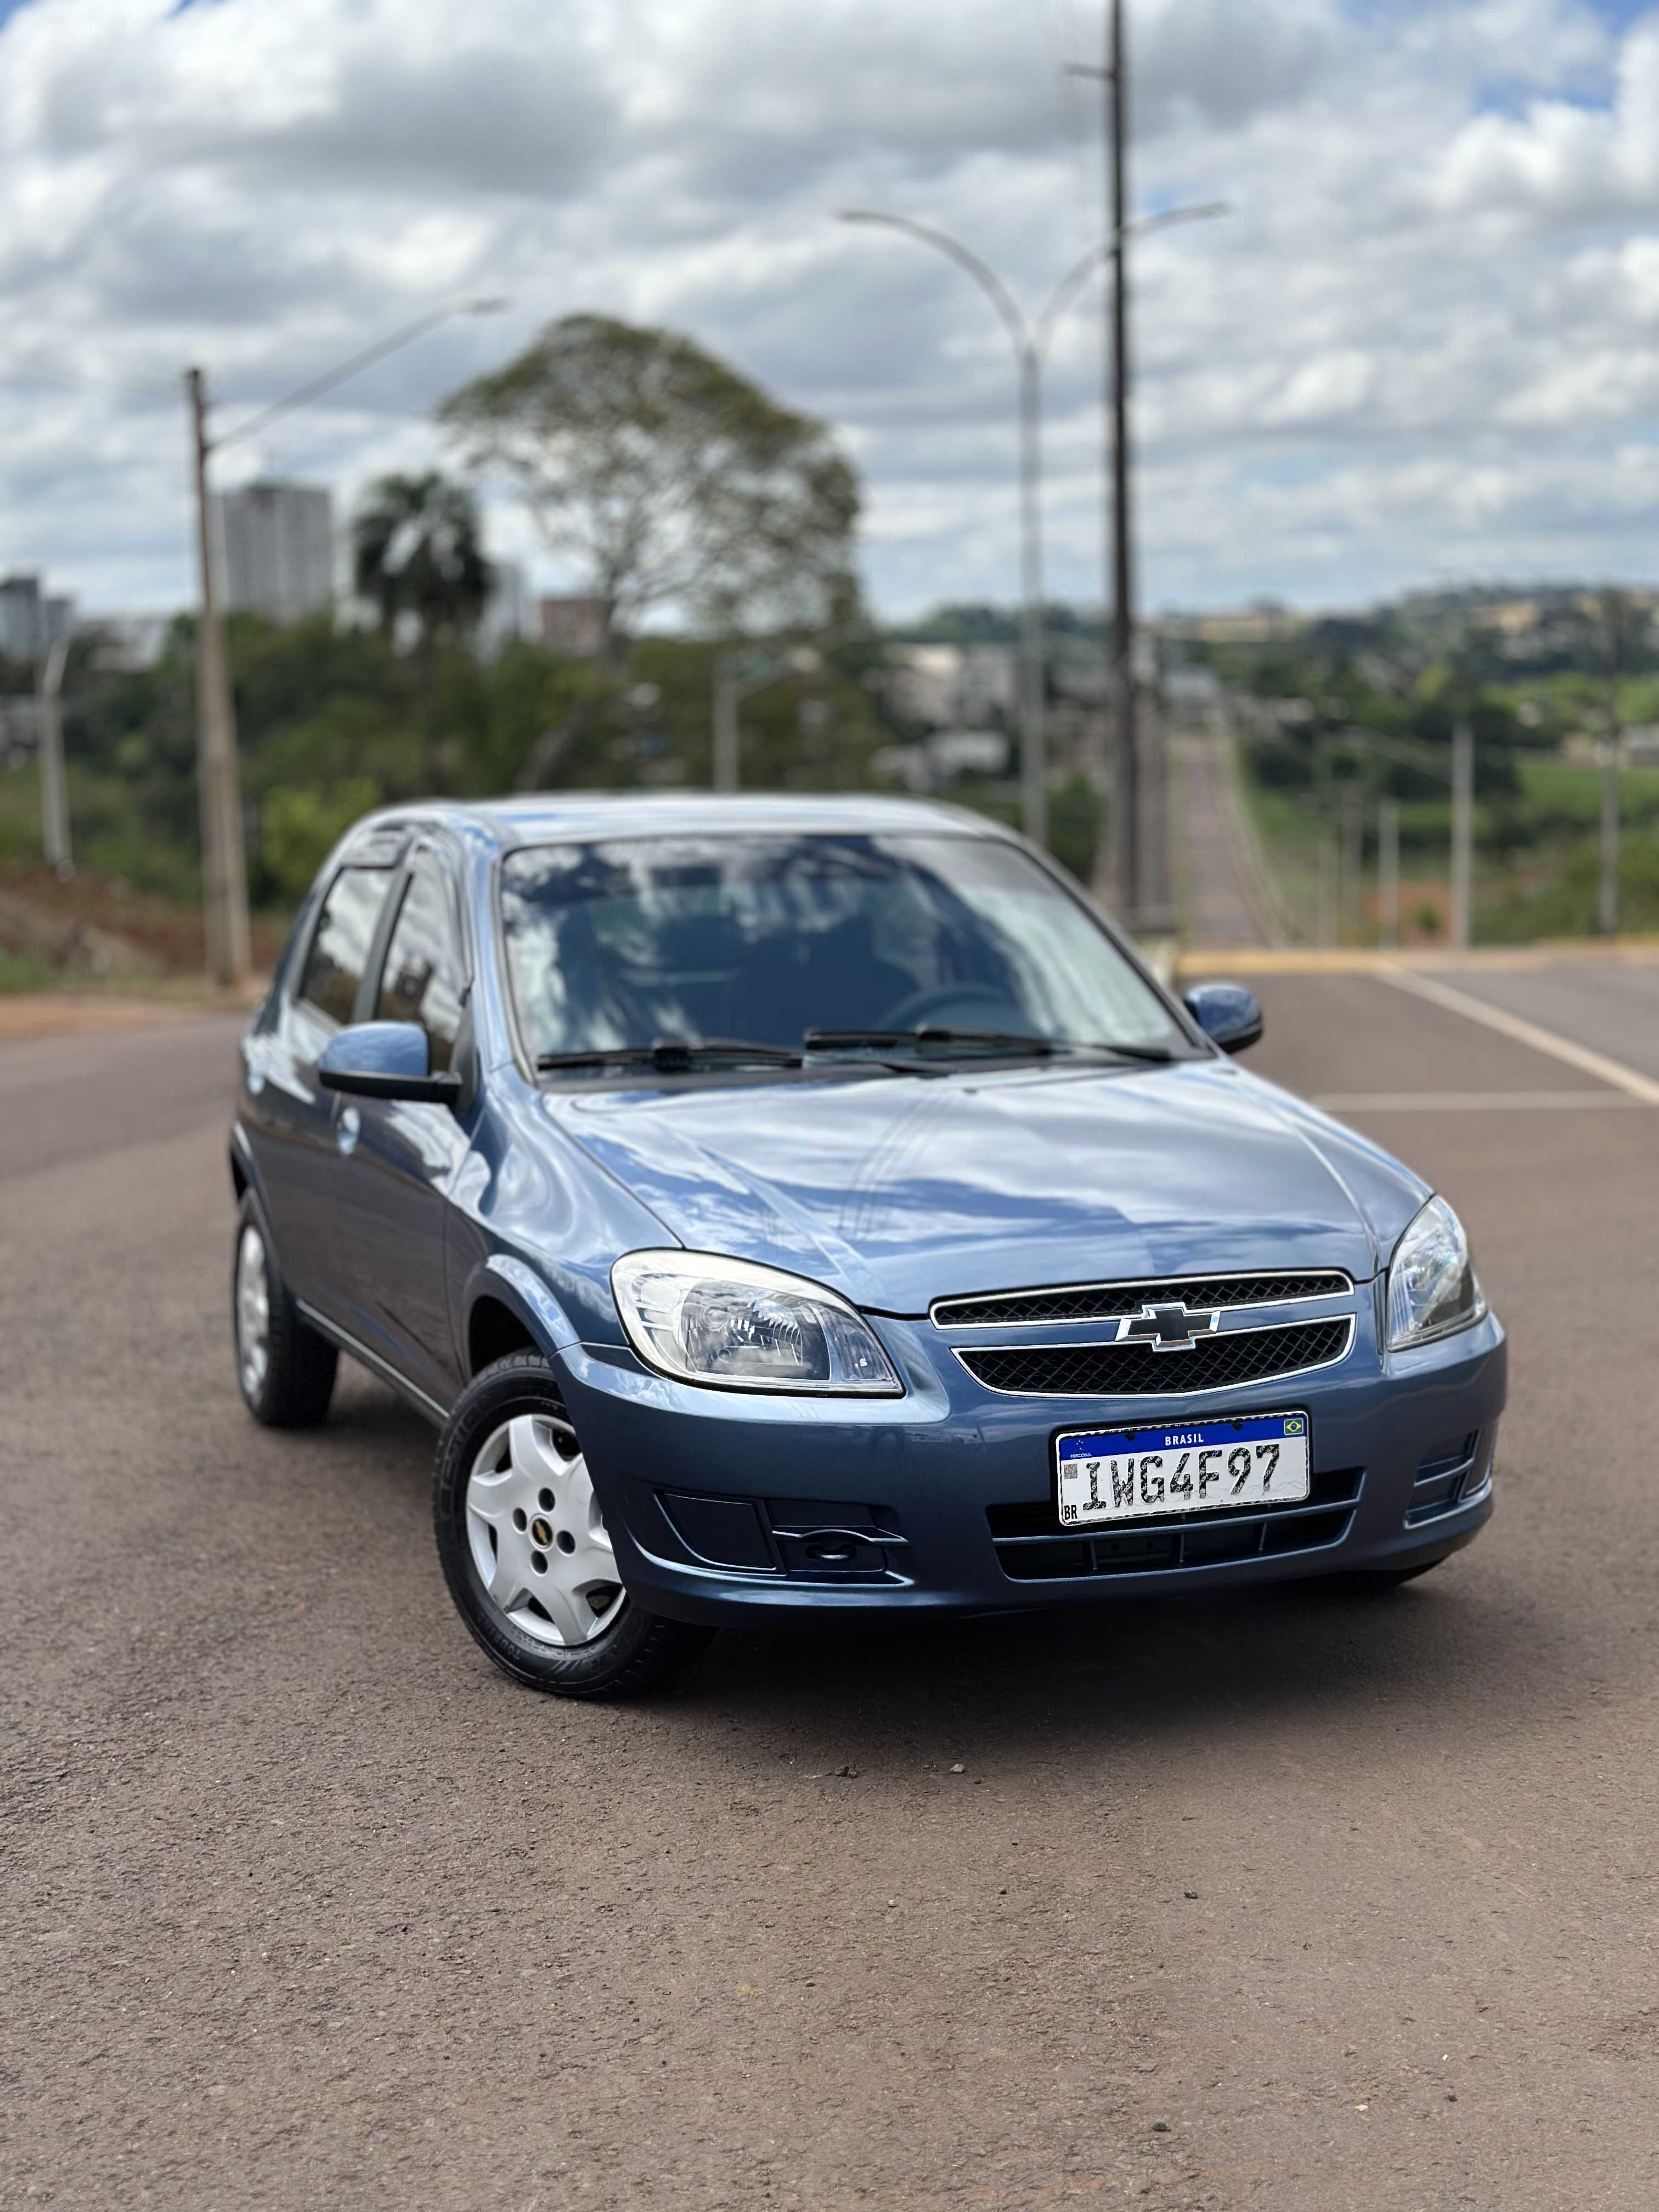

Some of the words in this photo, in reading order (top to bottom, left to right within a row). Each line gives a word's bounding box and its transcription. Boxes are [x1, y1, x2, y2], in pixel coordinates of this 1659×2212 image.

[1165, 1433, 1204, 1446] BRASIL
[1083, 1443, 1280, 1510] IWG4F97
[1064, 1505, 1078, 1520] BR
